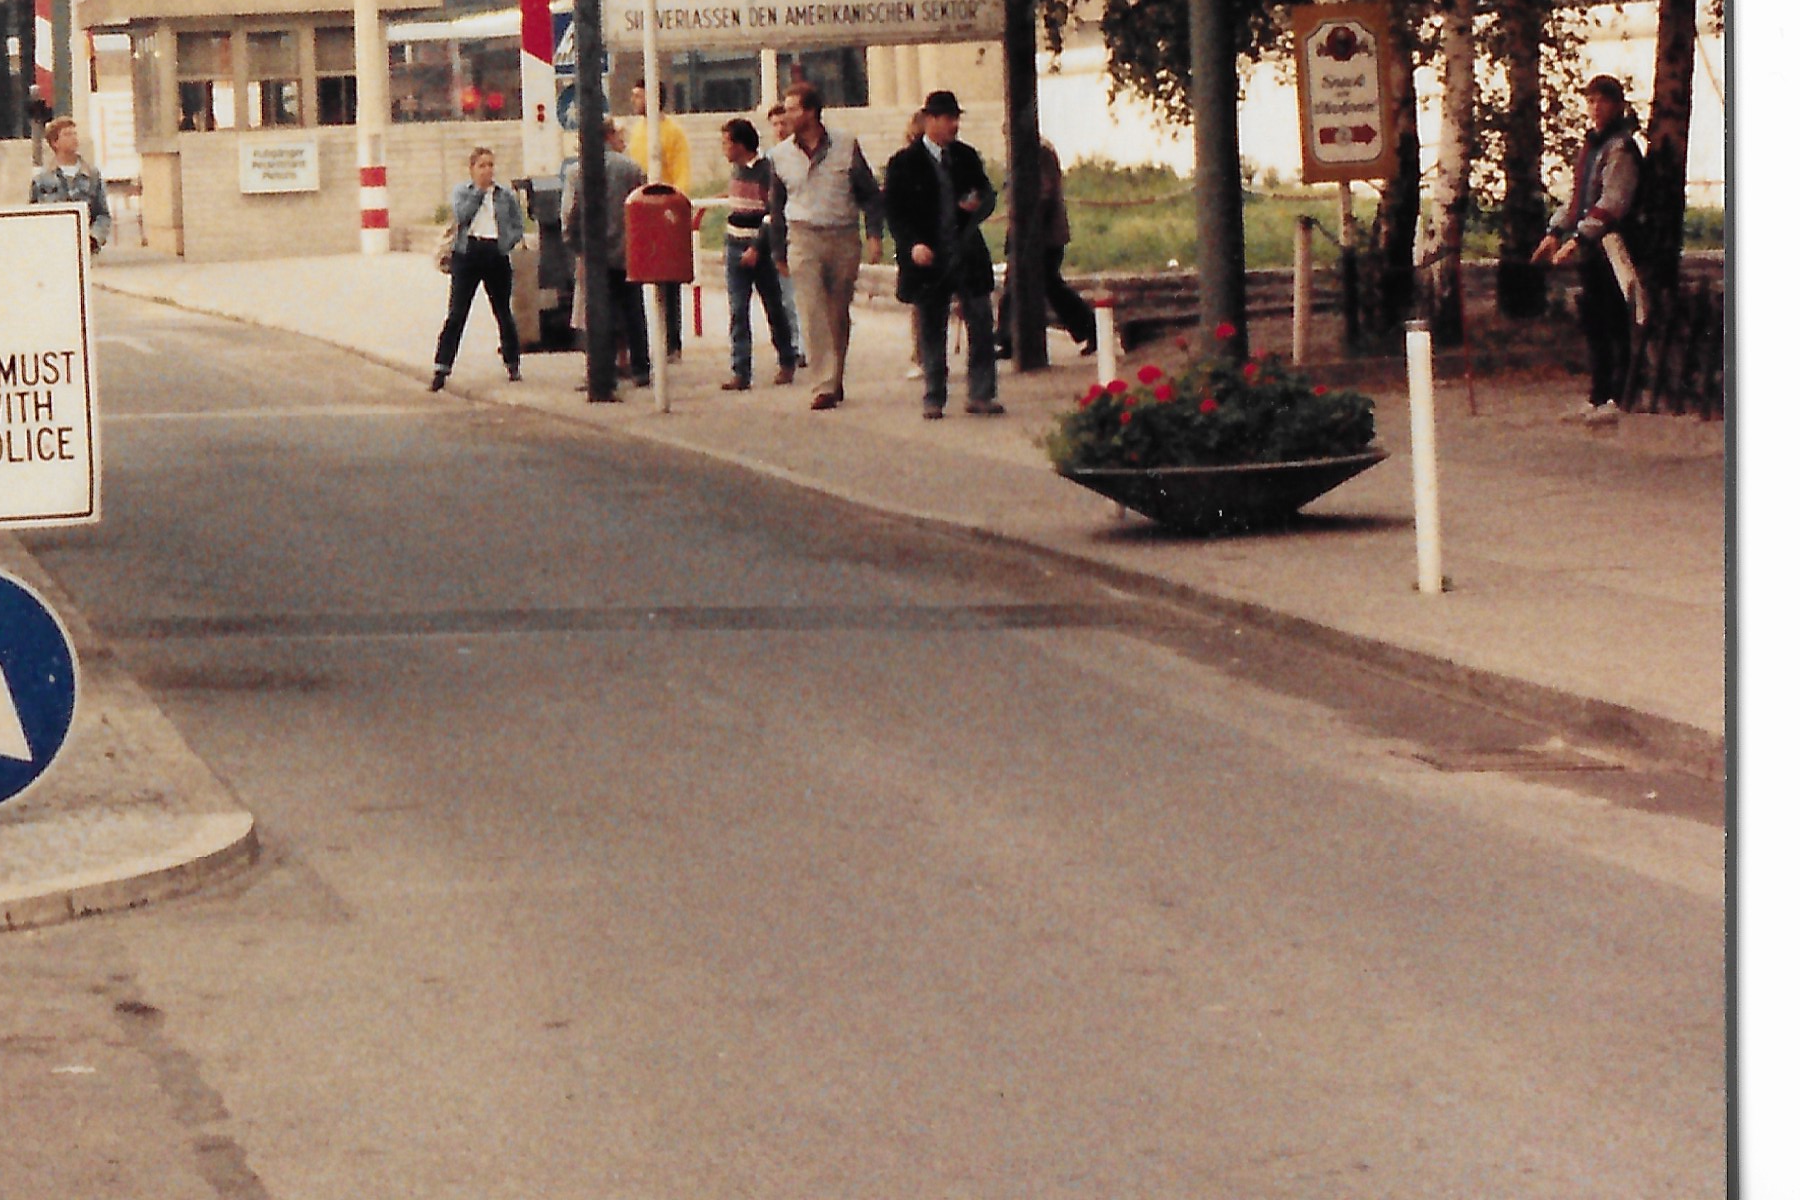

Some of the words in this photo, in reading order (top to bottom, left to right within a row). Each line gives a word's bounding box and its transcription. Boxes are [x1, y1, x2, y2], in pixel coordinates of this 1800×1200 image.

[655, 6, 741, 30] VERLASSEN
[749, 6, 778, 28] DEN
[785, 2, 915, 26] AMERIKANISCHEN
[922, 0, 979, 22] SEKTOR
